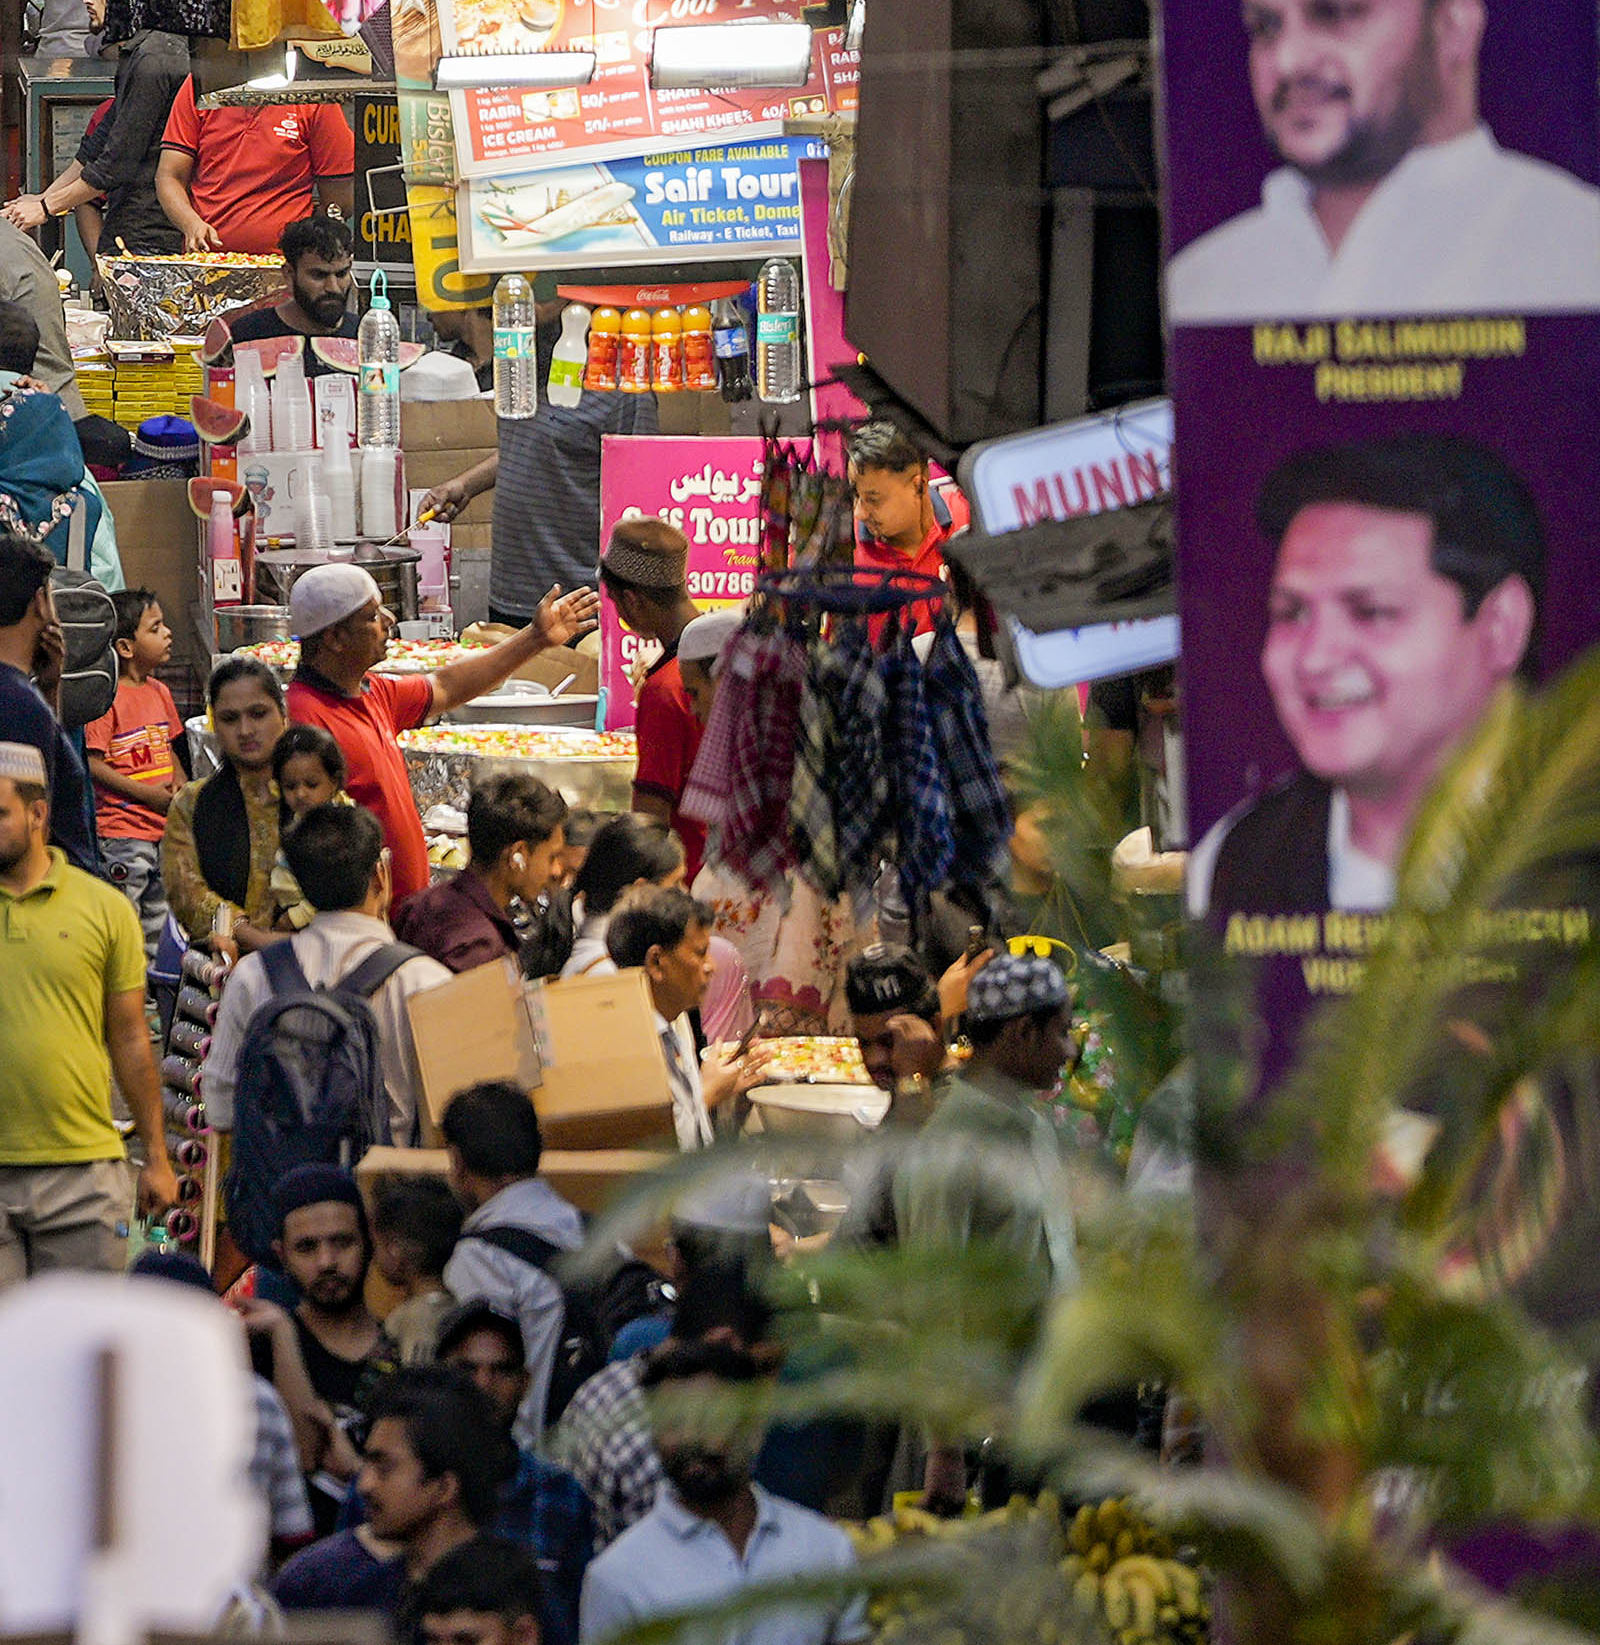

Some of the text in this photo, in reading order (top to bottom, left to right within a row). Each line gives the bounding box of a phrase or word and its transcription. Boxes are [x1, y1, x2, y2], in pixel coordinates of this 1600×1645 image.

[660, 117, 705, 135] SHAHI
[483, 131, 506, 148] ICE
[506, 125, 557, 145] CREAM
[695, 148, 724, 164] FARE
[727, 144, 789, 161] AVAILABLE
[644, 167, 713, 205] Saif
[661, 209, 686, 226] Air
[691, 205, 750, 225] Ticket,
[669, 228, 713, 244] Railway
[724, 226, 732, 240] E
